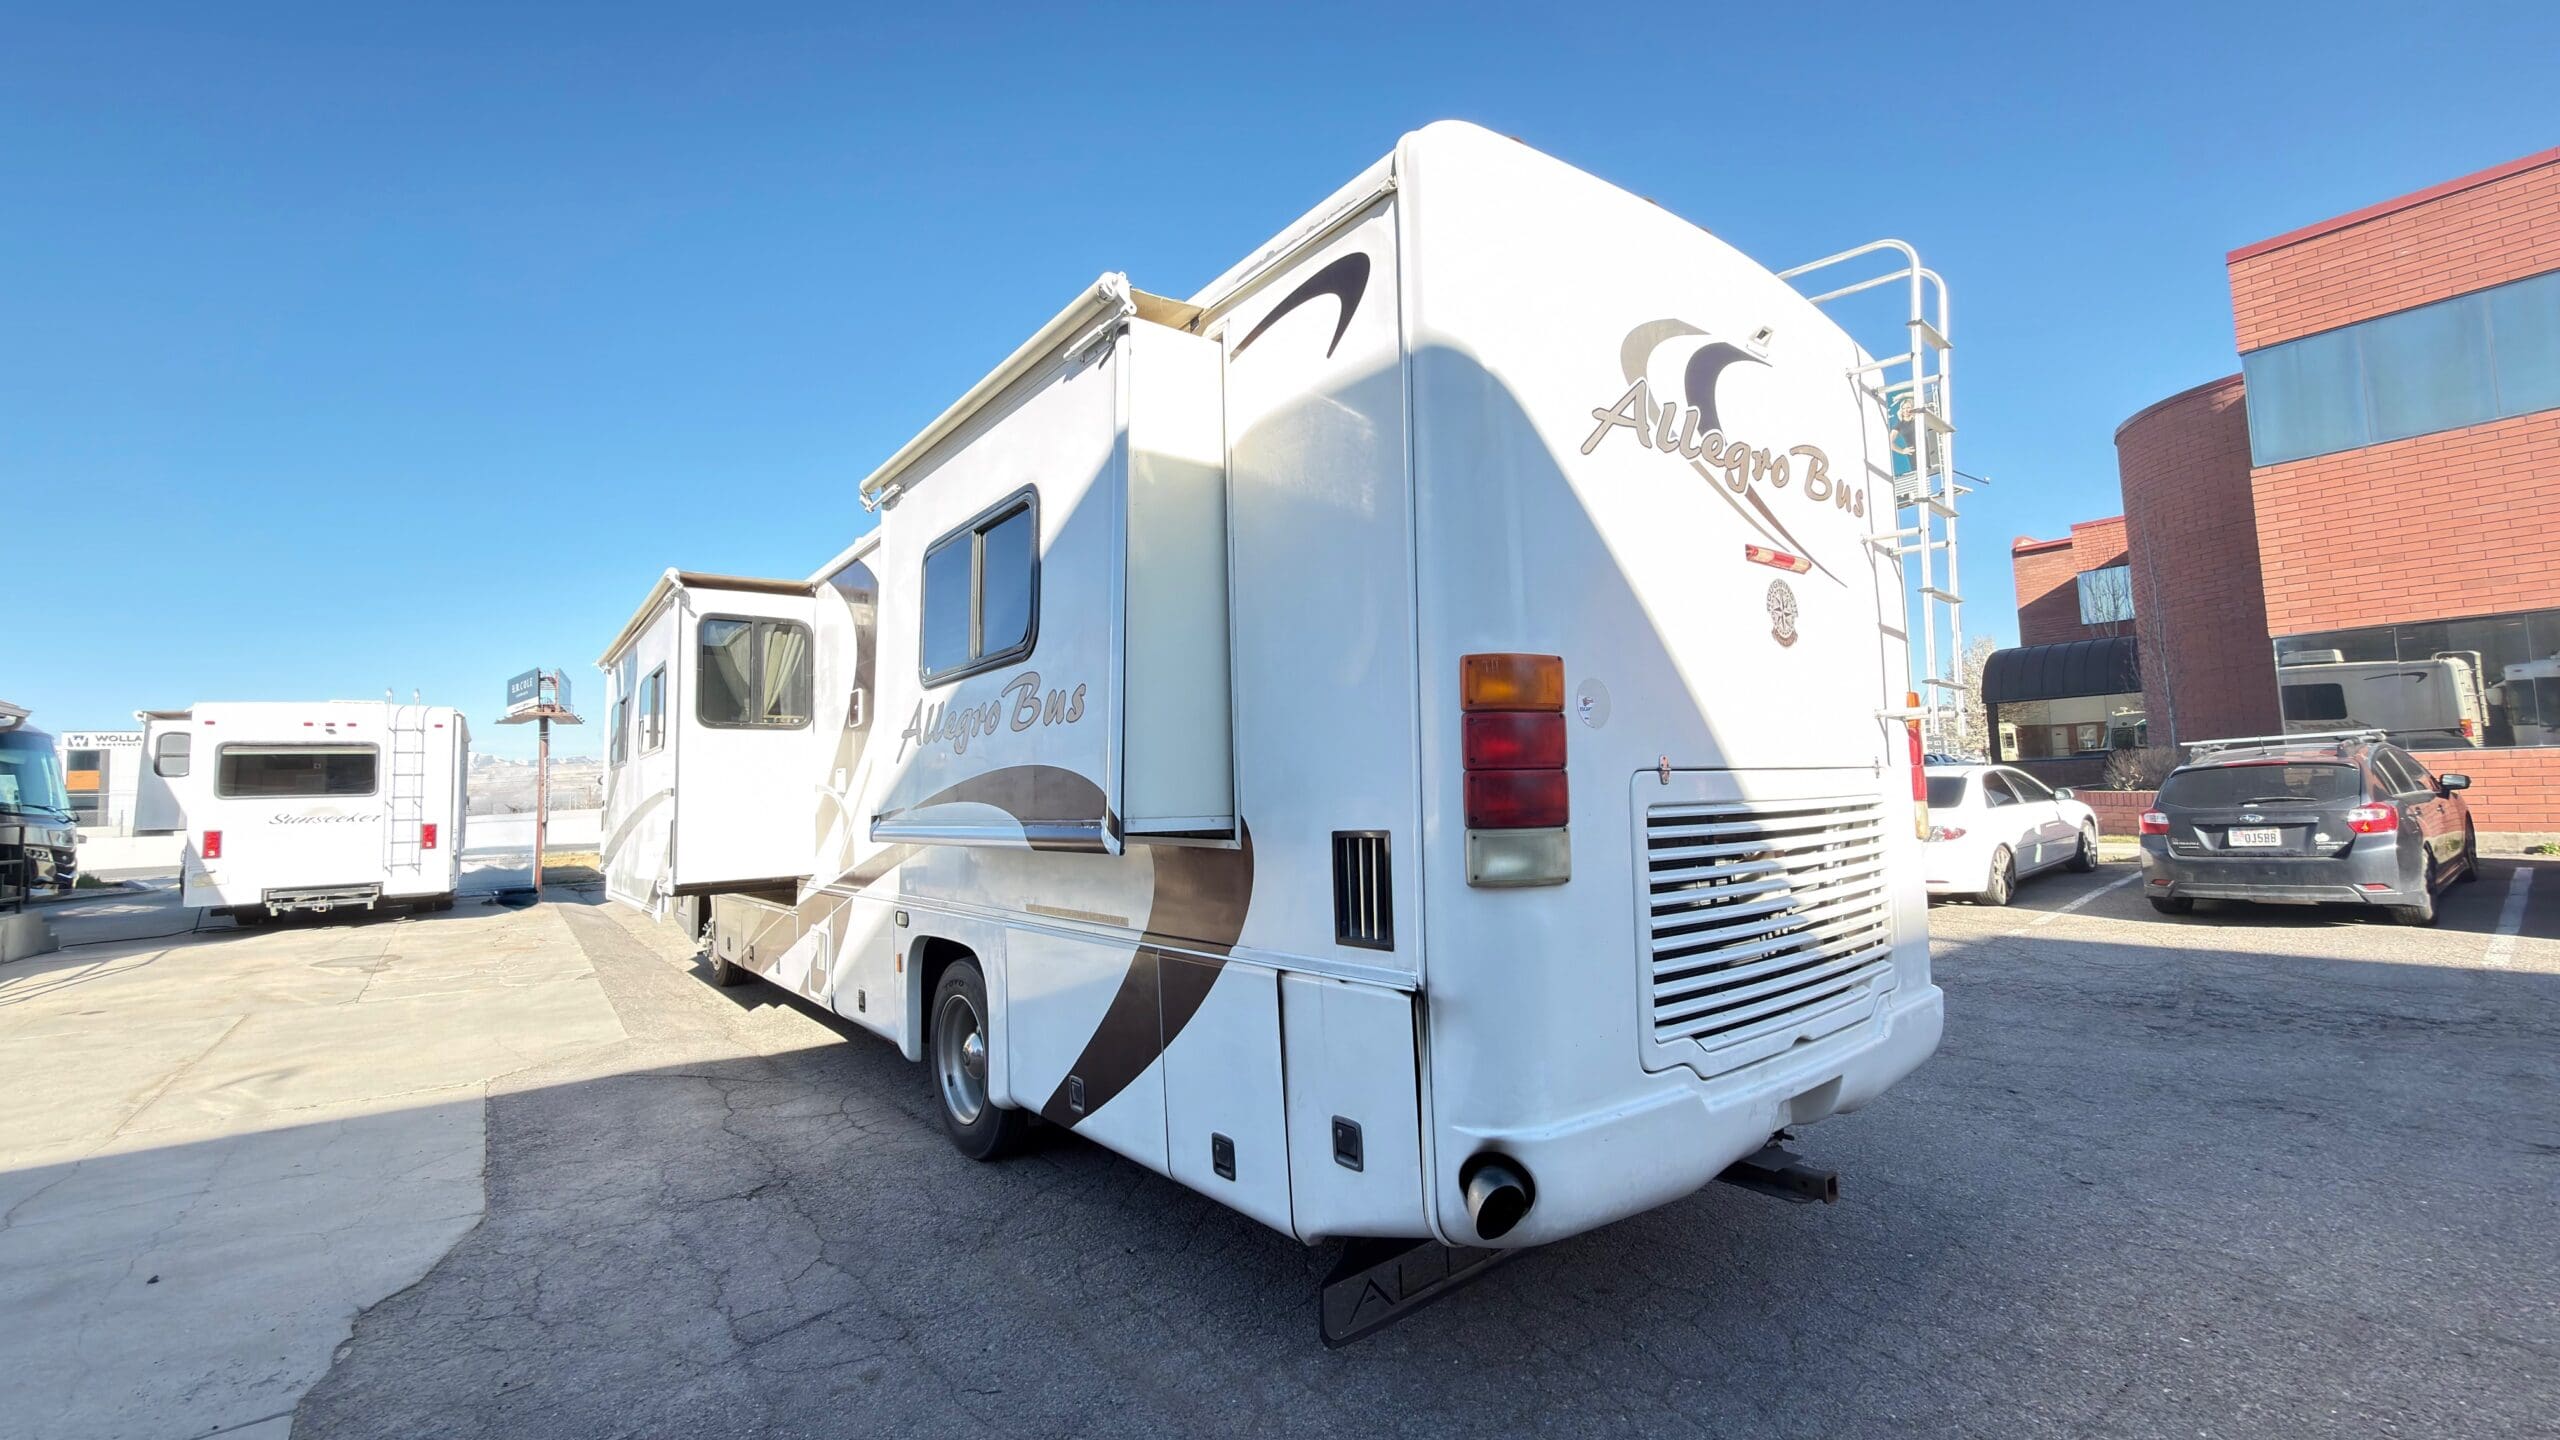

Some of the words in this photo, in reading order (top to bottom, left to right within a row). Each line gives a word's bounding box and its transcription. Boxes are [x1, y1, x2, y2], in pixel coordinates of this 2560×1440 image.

[1580, 380, 1790, 494] Allegro
[1789, 444, 1865, 518] Bus
[896, 697, 1002, 764] Allegro
[1000, 671, 1087, 732] Bus
